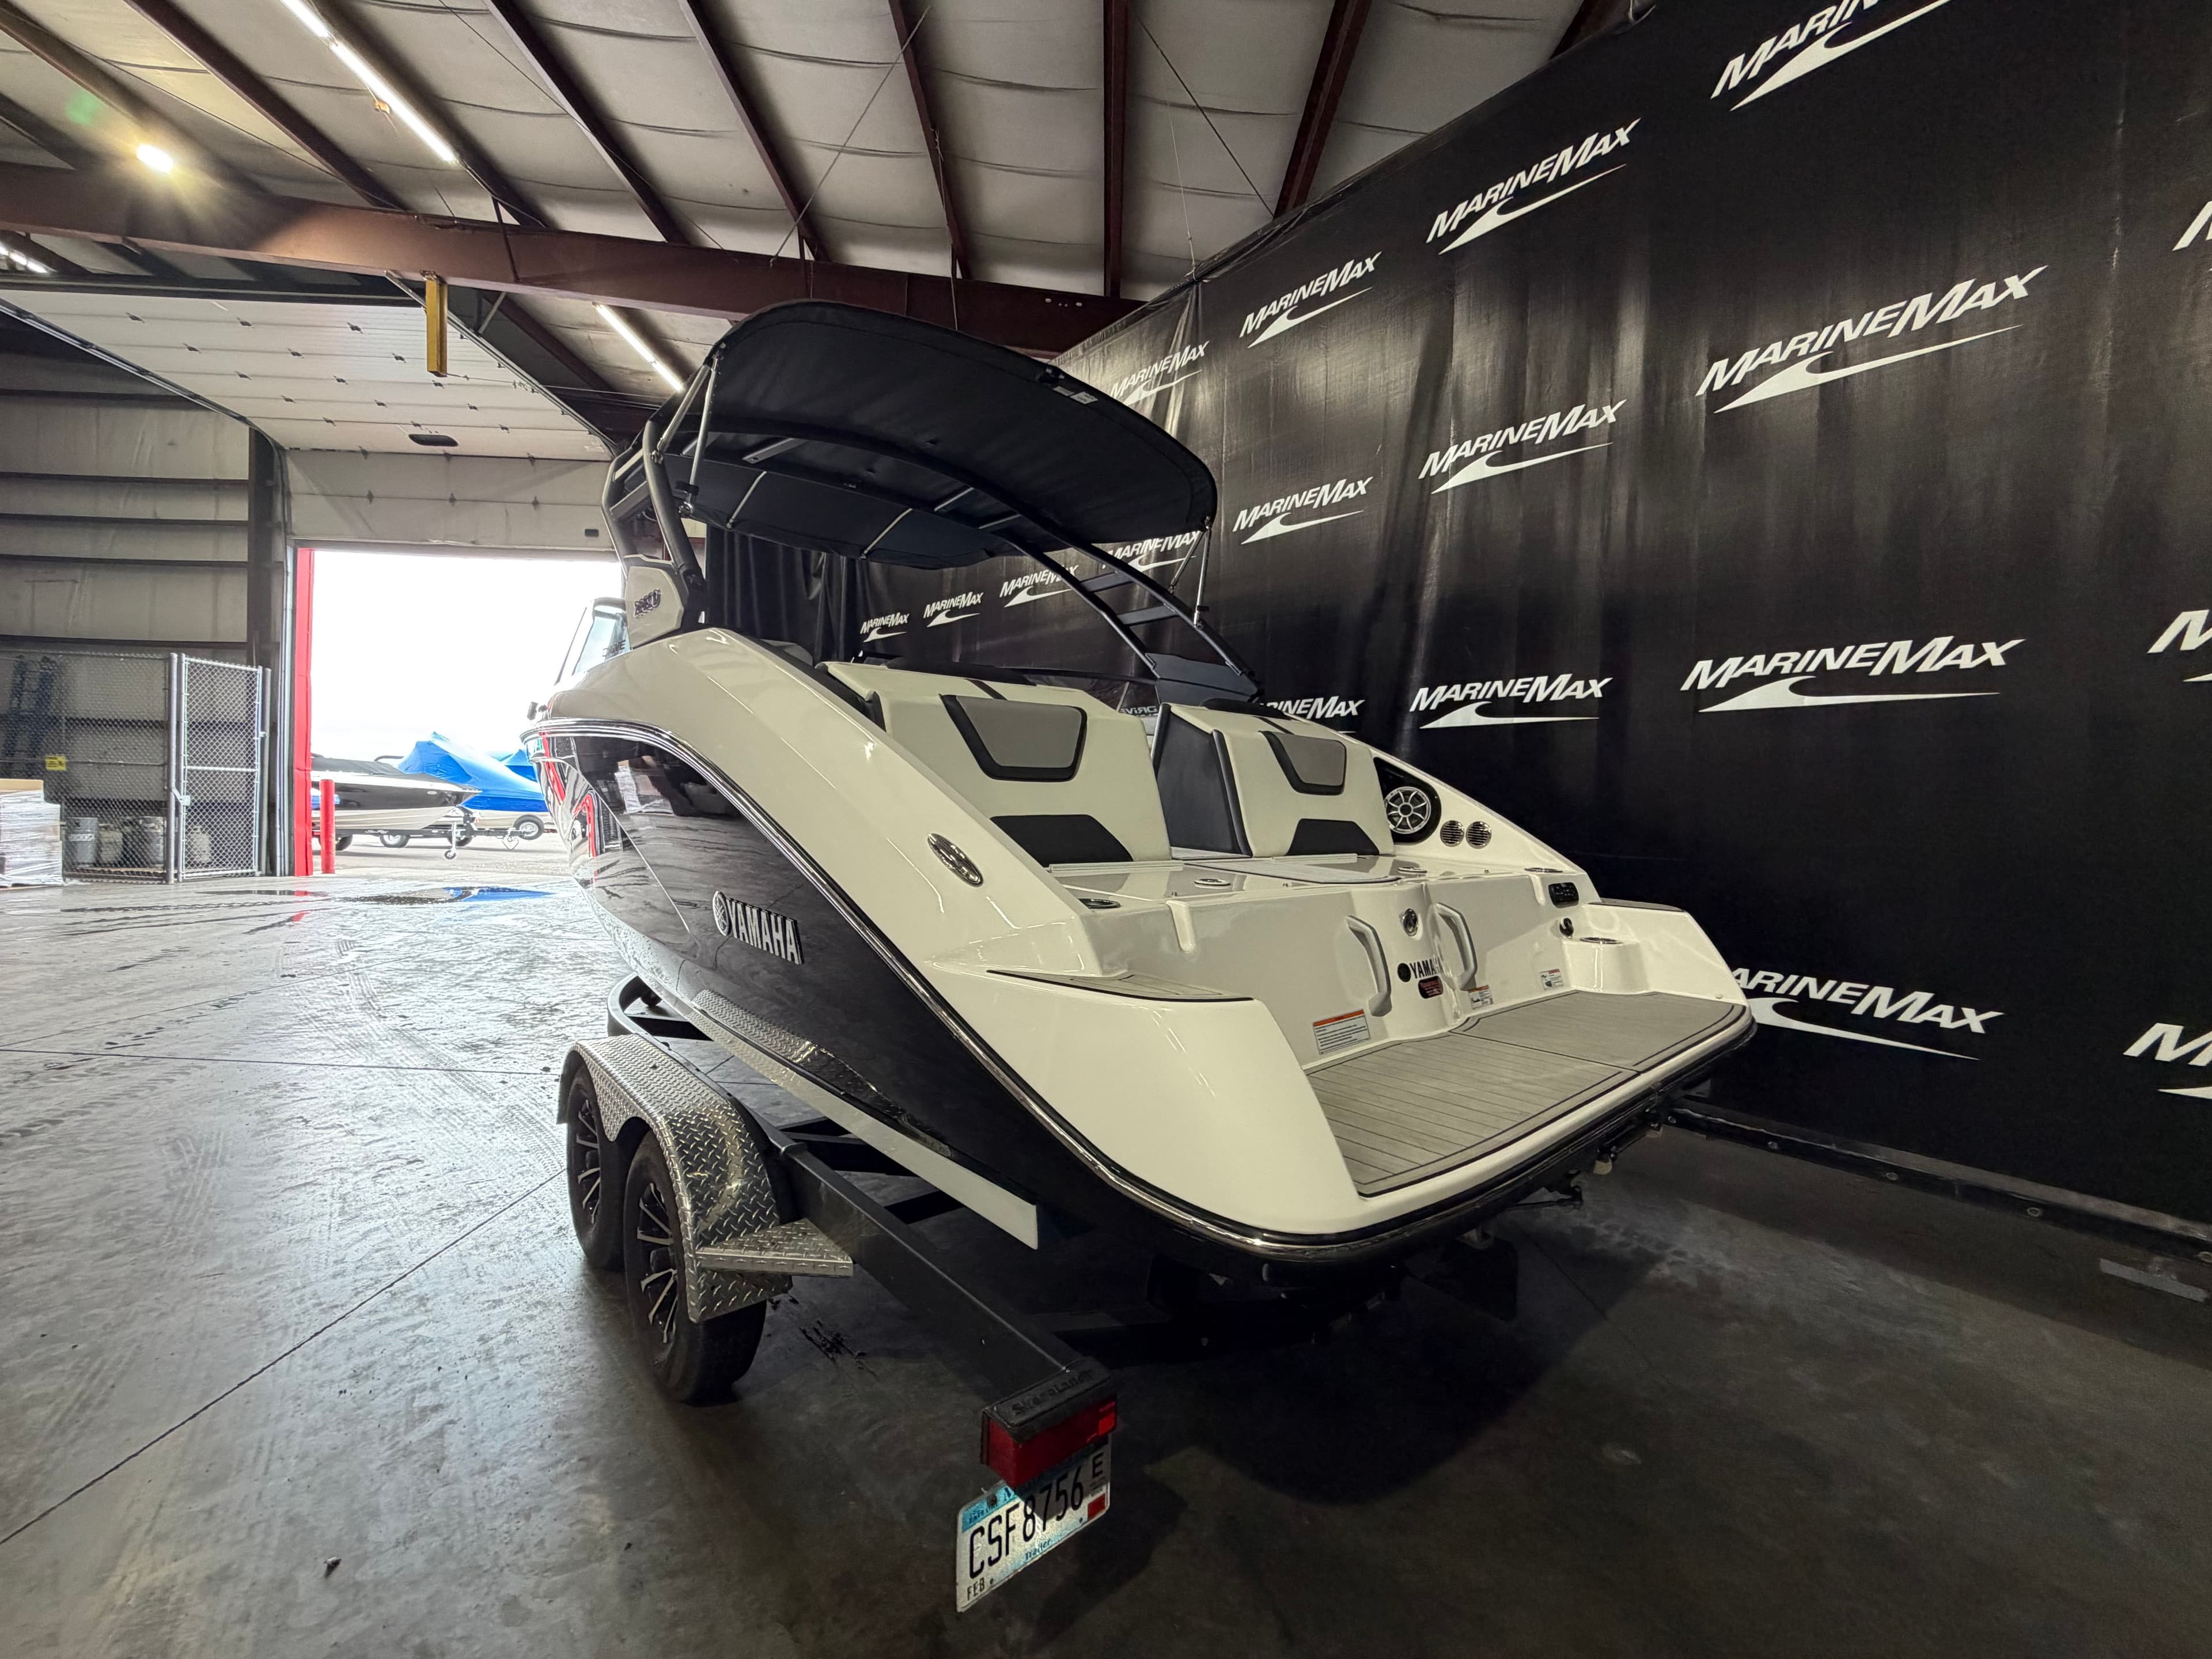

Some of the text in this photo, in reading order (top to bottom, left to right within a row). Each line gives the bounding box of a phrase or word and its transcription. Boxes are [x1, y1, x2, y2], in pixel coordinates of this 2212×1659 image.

[999, 565, 1079, 598] MARINEMX
[726, 897, 803, 965] YAMAHA
[1730, 968, 2005, 1034] ARINEMAX
[969, 1452, 1104, 1579] CSF8756 E
